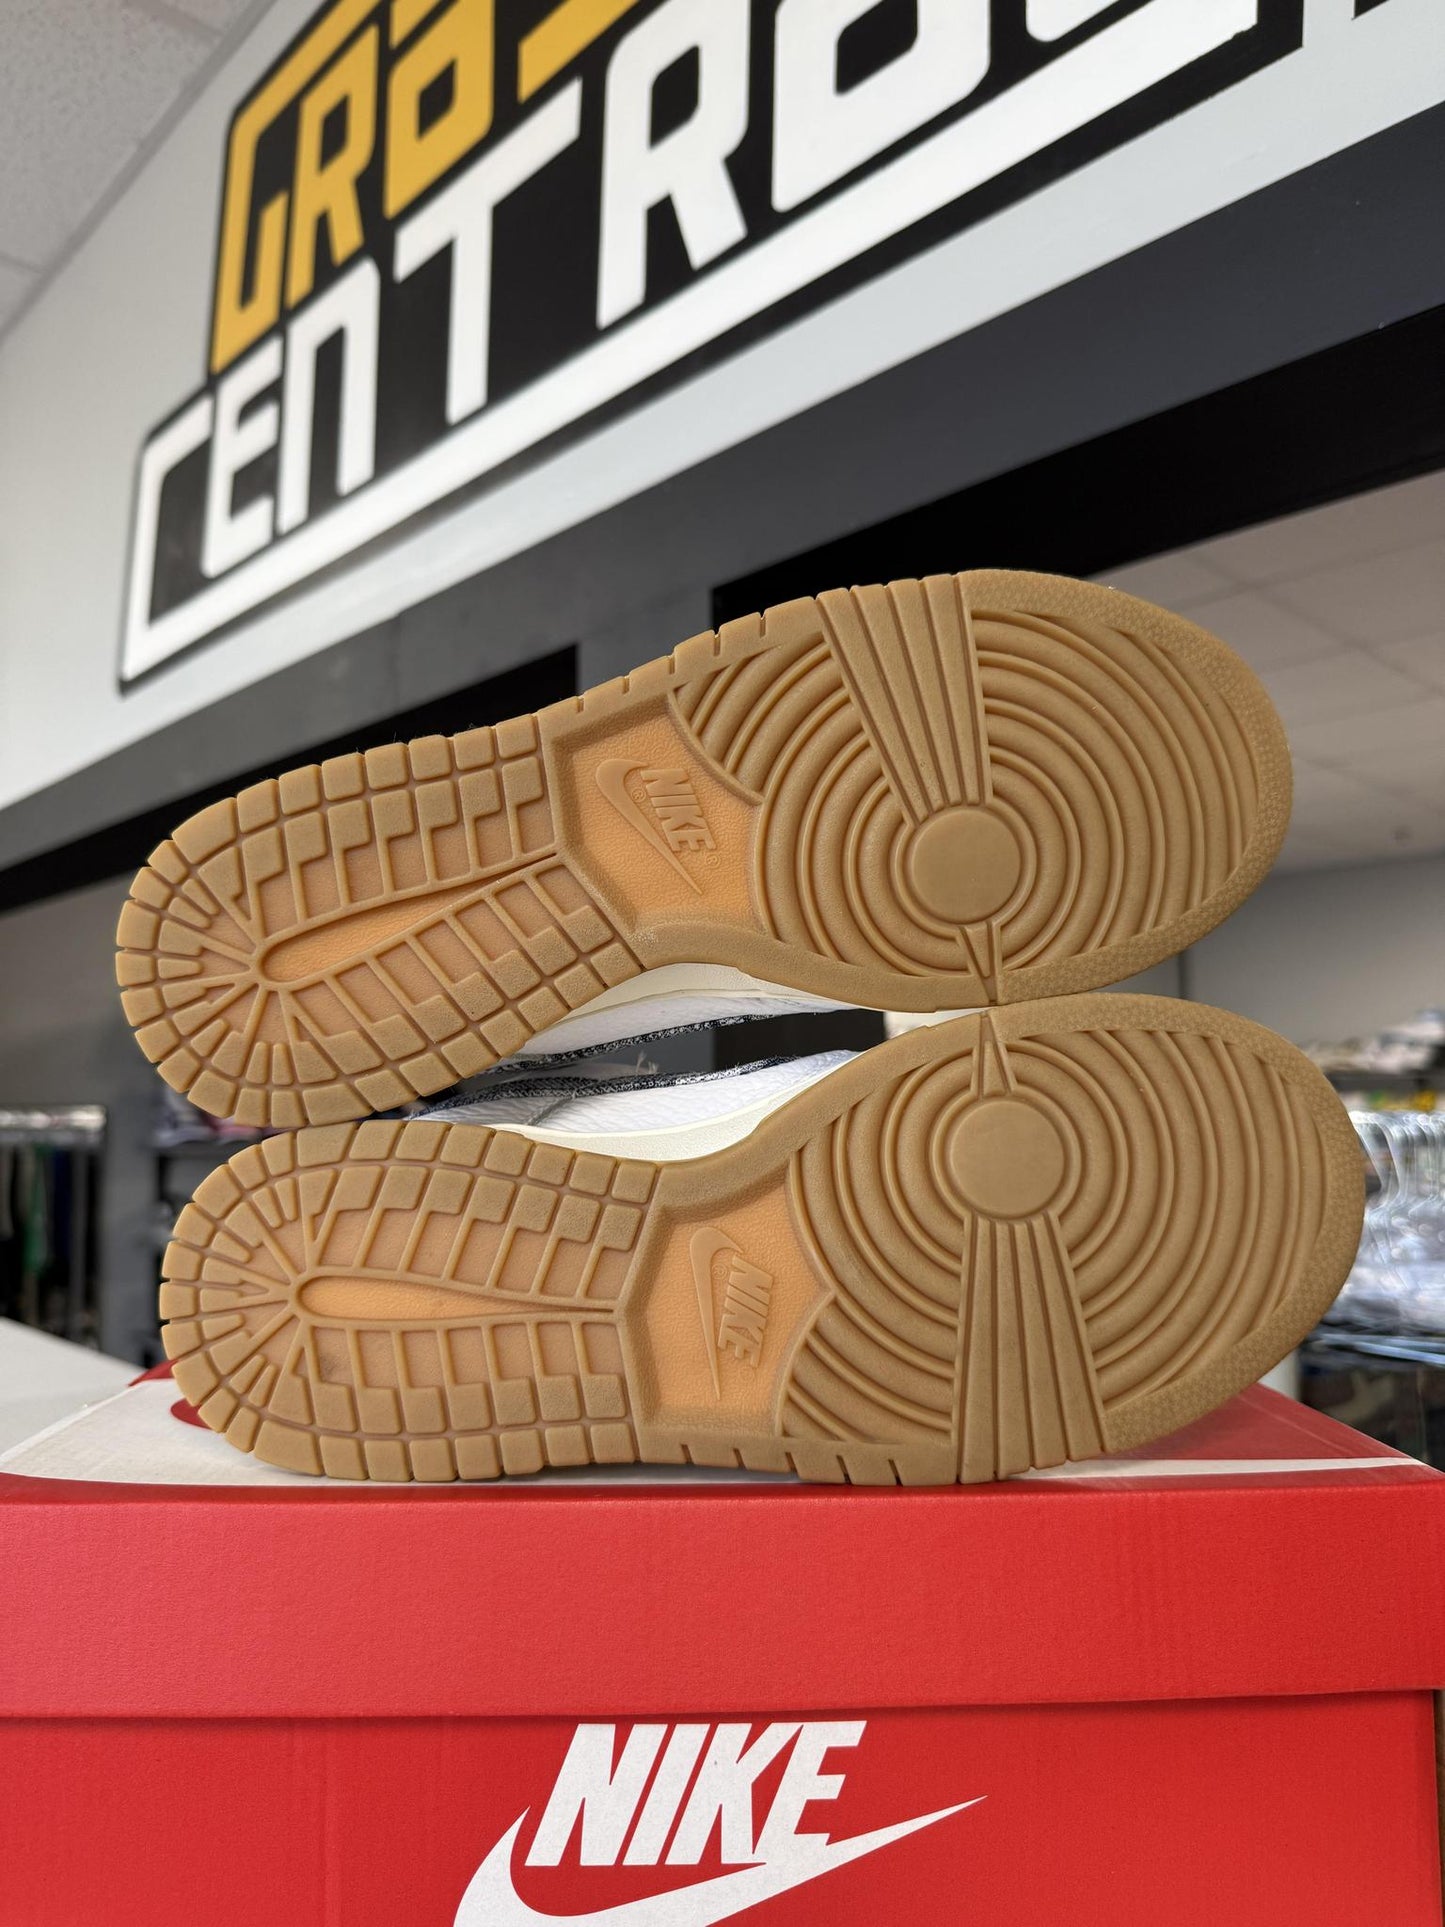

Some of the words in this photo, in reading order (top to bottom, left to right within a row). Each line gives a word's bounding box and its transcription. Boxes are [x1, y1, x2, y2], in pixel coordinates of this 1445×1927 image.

[640, 768, 717, 852] NIKE
[717, 1254, 774, 1369] NIKE
[524, 1720, 867, 1867] NIKE
